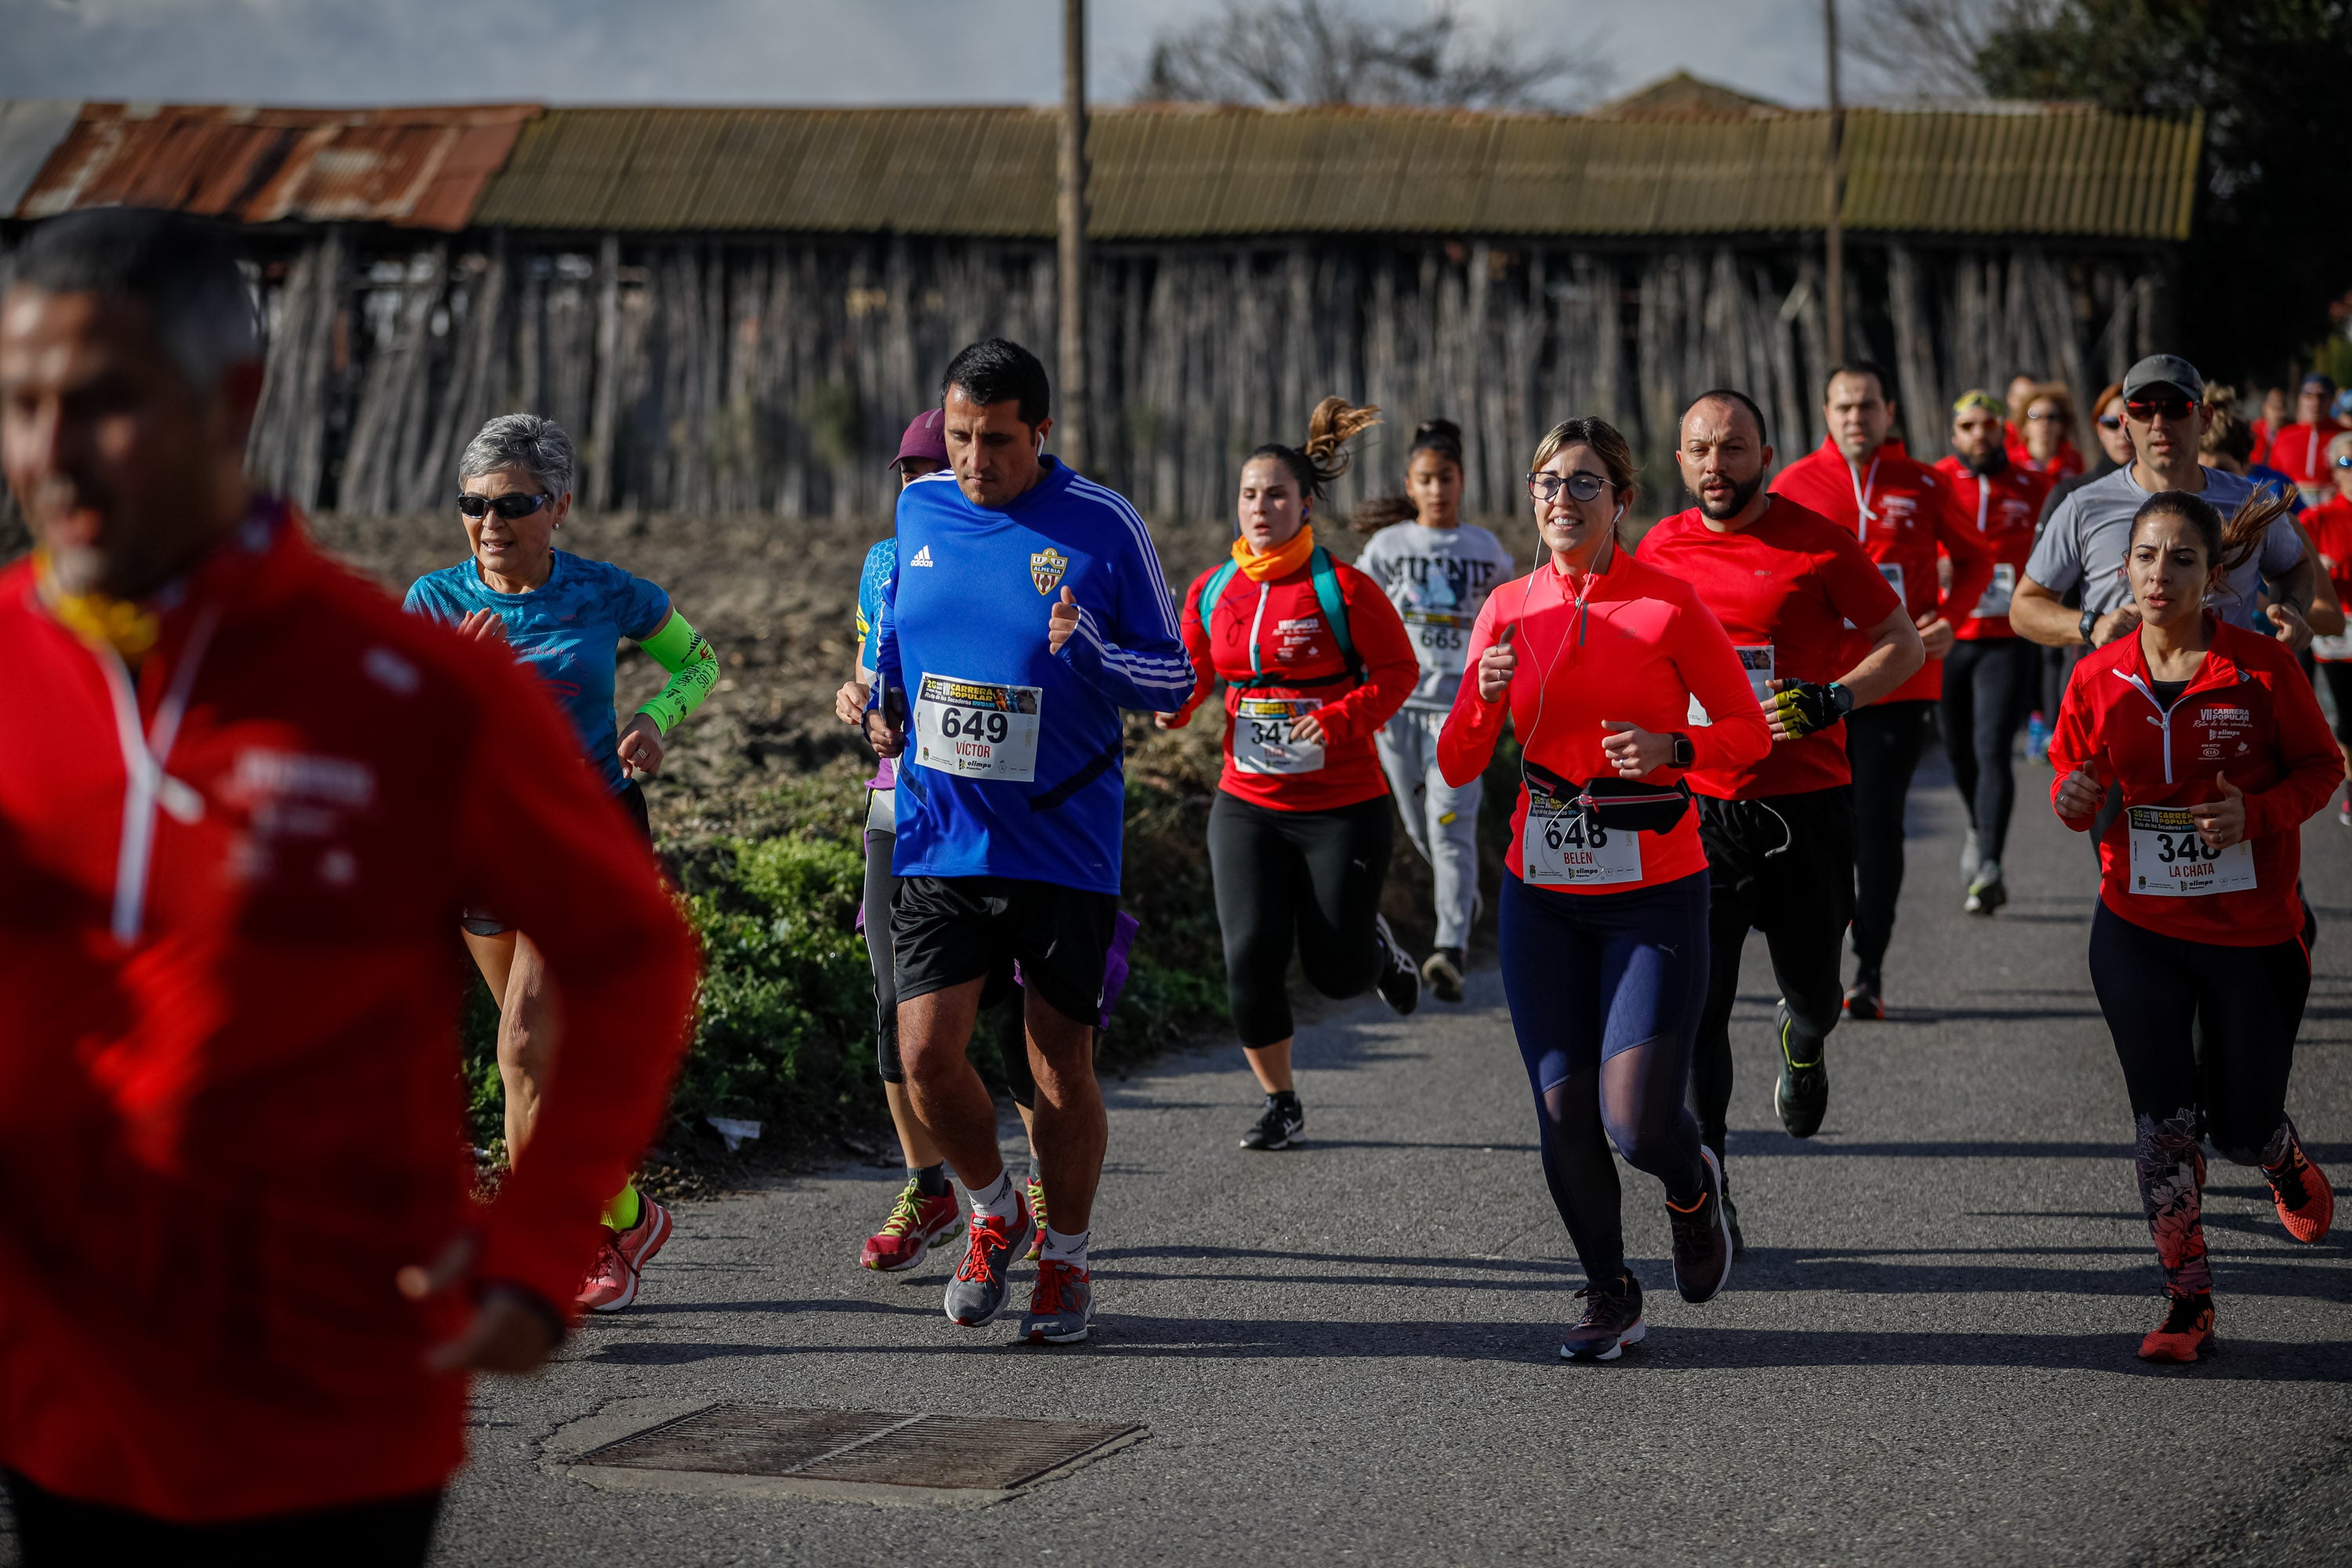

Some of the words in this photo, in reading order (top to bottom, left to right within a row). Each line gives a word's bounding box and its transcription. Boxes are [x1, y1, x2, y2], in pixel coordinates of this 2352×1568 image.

[910, 557, 934, 568] adidas
[1384, 555, 1495, 587] MINNIE
[950, 684, 993, 695] CARRERA
[947, 696, 971, 705] Secaderos
[950, 691, 993, 702] POPULAR
[2201, 709, 2212, 720] VII
[942, 707, 1008, 744] 649
[956, 740, 991, 758] VÍCTOR
[967, 760, 992, 769] olimpo
[2151, 811, 2159, 823] VII
[1545, 819, 1607, 849] 648
[2157, 833, 2222, 863] 348
[1564, 850, 1593, 865] BELÉN
[2169, 866, 2181, 877] LA
[2183, 862, 2215, 877] CHATA
